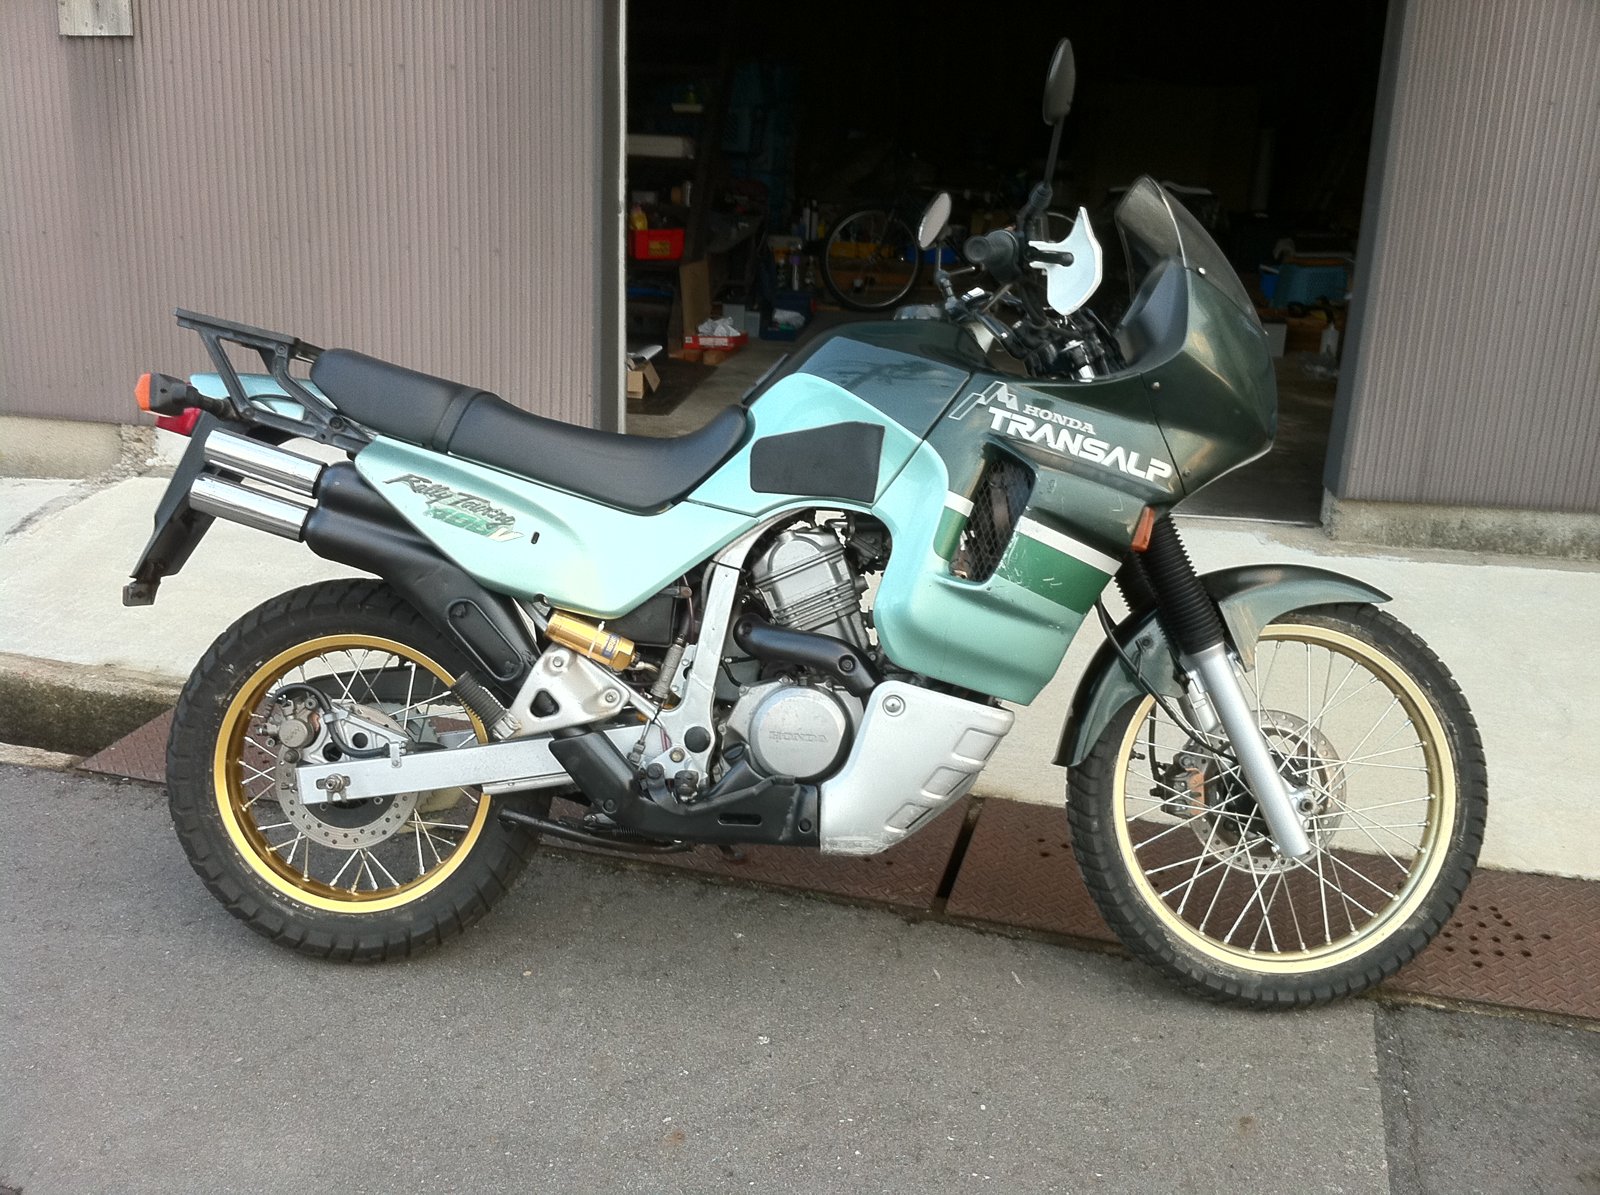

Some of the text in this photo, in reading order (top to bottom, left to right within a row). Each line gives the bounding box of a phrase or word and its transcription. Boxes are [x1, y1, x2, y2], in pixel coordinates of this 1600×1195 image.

[1022, 404, 1096, 435] HONDA
[988, 406, 1173, 481] TRANSALP
[767, 730, 829, 743] HONDA
